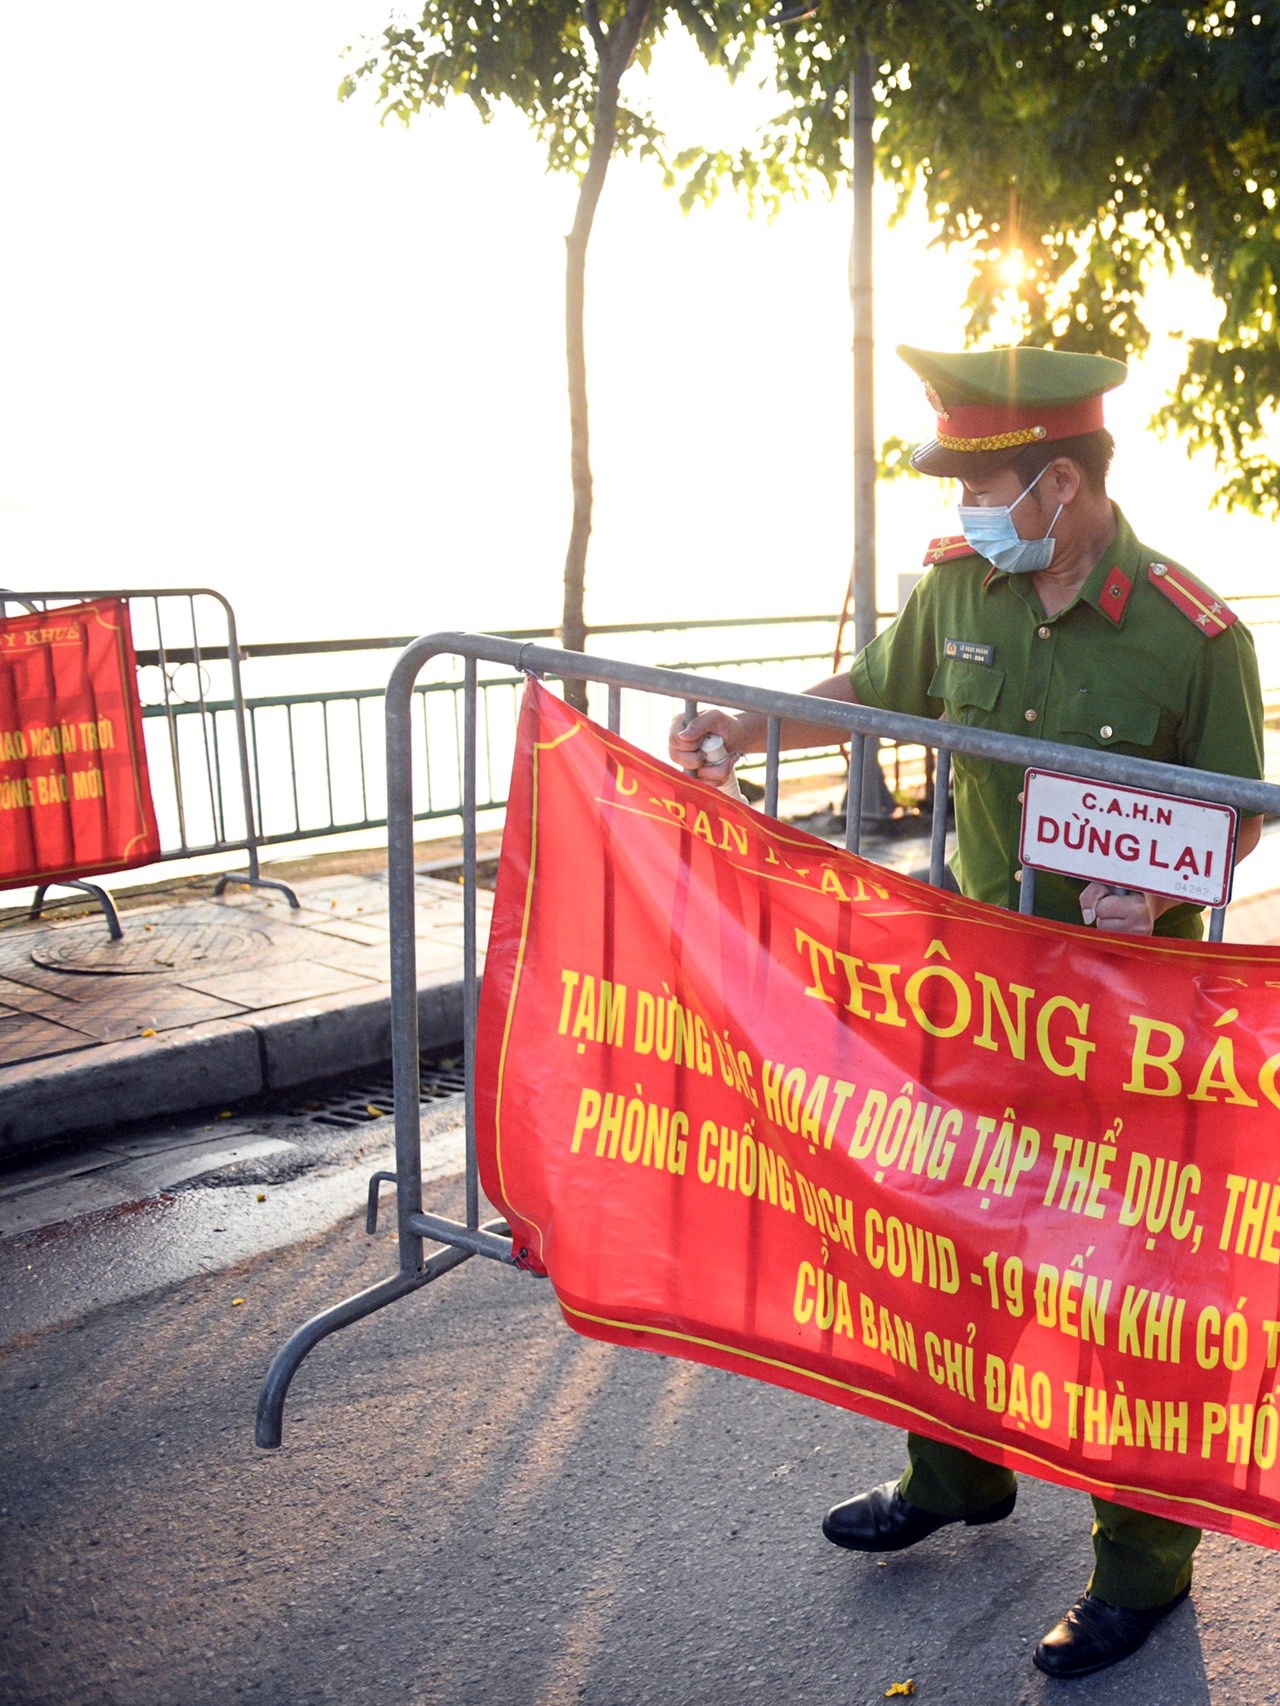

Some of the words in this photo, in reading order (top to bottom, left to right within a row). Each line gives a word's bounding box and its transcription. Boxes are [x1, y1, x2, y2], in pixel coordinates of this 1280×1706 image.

[0, 731, 28, 762] AO
[29, 719, 77, 757] NGOÀI
[79, 713, 114, 751] TRỜI
[0, 775, 35, 811] ÔNG
[37, 768, 70, 805] BÁO
[73, 761, 104, 800] MỚI
[1037, 812, 1140, 862] DỪNG
[1149, 839, 1214, 881] LẠI
[1082, 792, 1172, 826] C.A.H.N
[794, 927, 1096, 1082] THÔNG
[558, 969, 627, 1055] TẠM
[634, 981, 713, 1077] DỪNG
[762, 1059, 857, 1156] HOẠT
[848, 1082, 964, 1184] ĐỘNG
[963, 1107, 1041, 1210] TẬP
[1043, 1117, 1124, 1220] THỂ
[1118, 1151, 1204, 1254] DỤC,
[570, 1082, 689, 1177] PHÒNG
[697, 1118, 797, 1215] CHỐNG
[794, 1169, 858, 1257] DỊCH
[865, 1207, 960, 1295] COVID
[1034, 1245, 1113, 1346] ĐẾN
[1118, 1284, 1186, 1364] KHI
[1196, 1296, 1248, 1371] CÓ
[793, 1245, 854, 1340] CỦA
[860, 1291, 919, 1372] BAN
[924, 1322, 976, 1402] CHỈ
[984, 1354, 1052, 1430] ĐẠO
[1064, 1380, 1188, 1455] THÀNH
